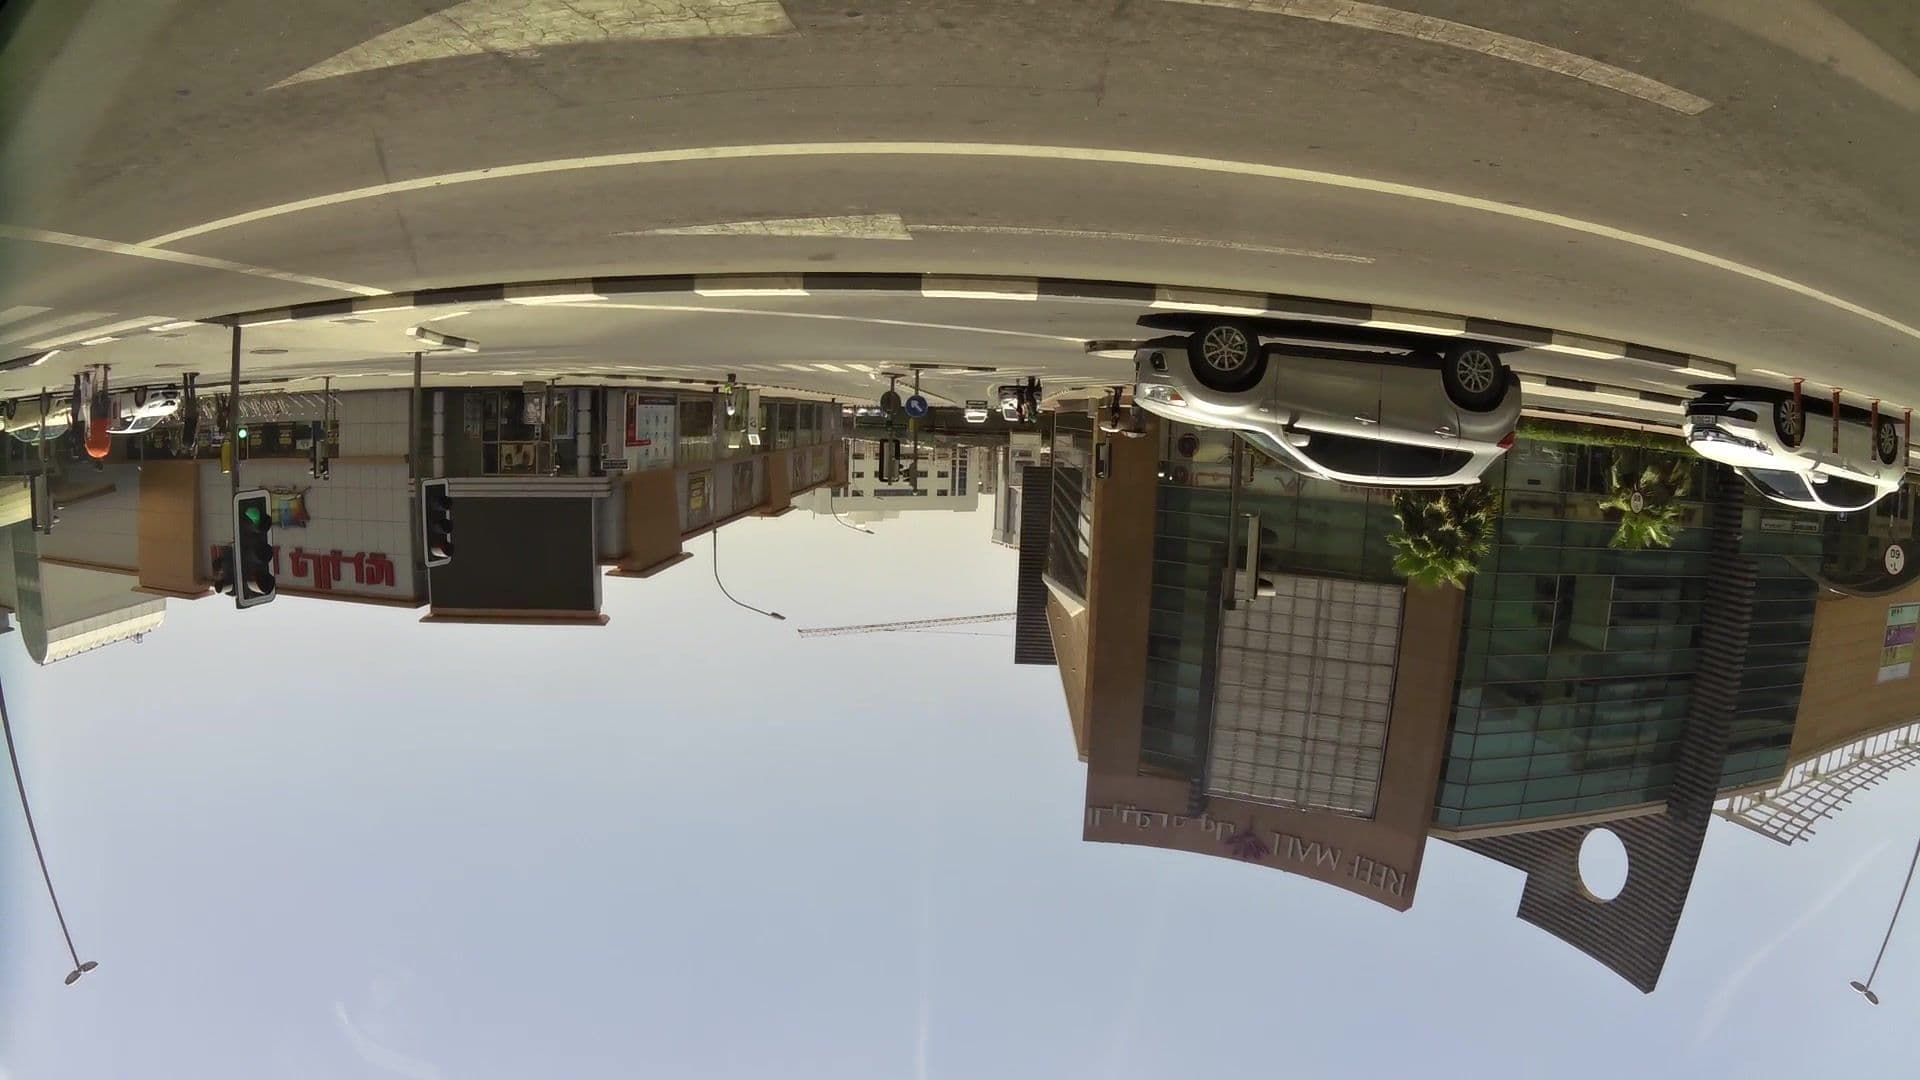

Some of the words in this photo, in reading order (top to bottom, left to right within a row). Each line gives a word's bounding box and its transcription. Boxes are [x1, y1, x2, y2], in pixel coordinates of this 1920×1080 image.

[1890, 549, 1900, 559] 60
[1272, 832, 1342, 870] MALL
[1347, 855, 1407, 897] REEF
